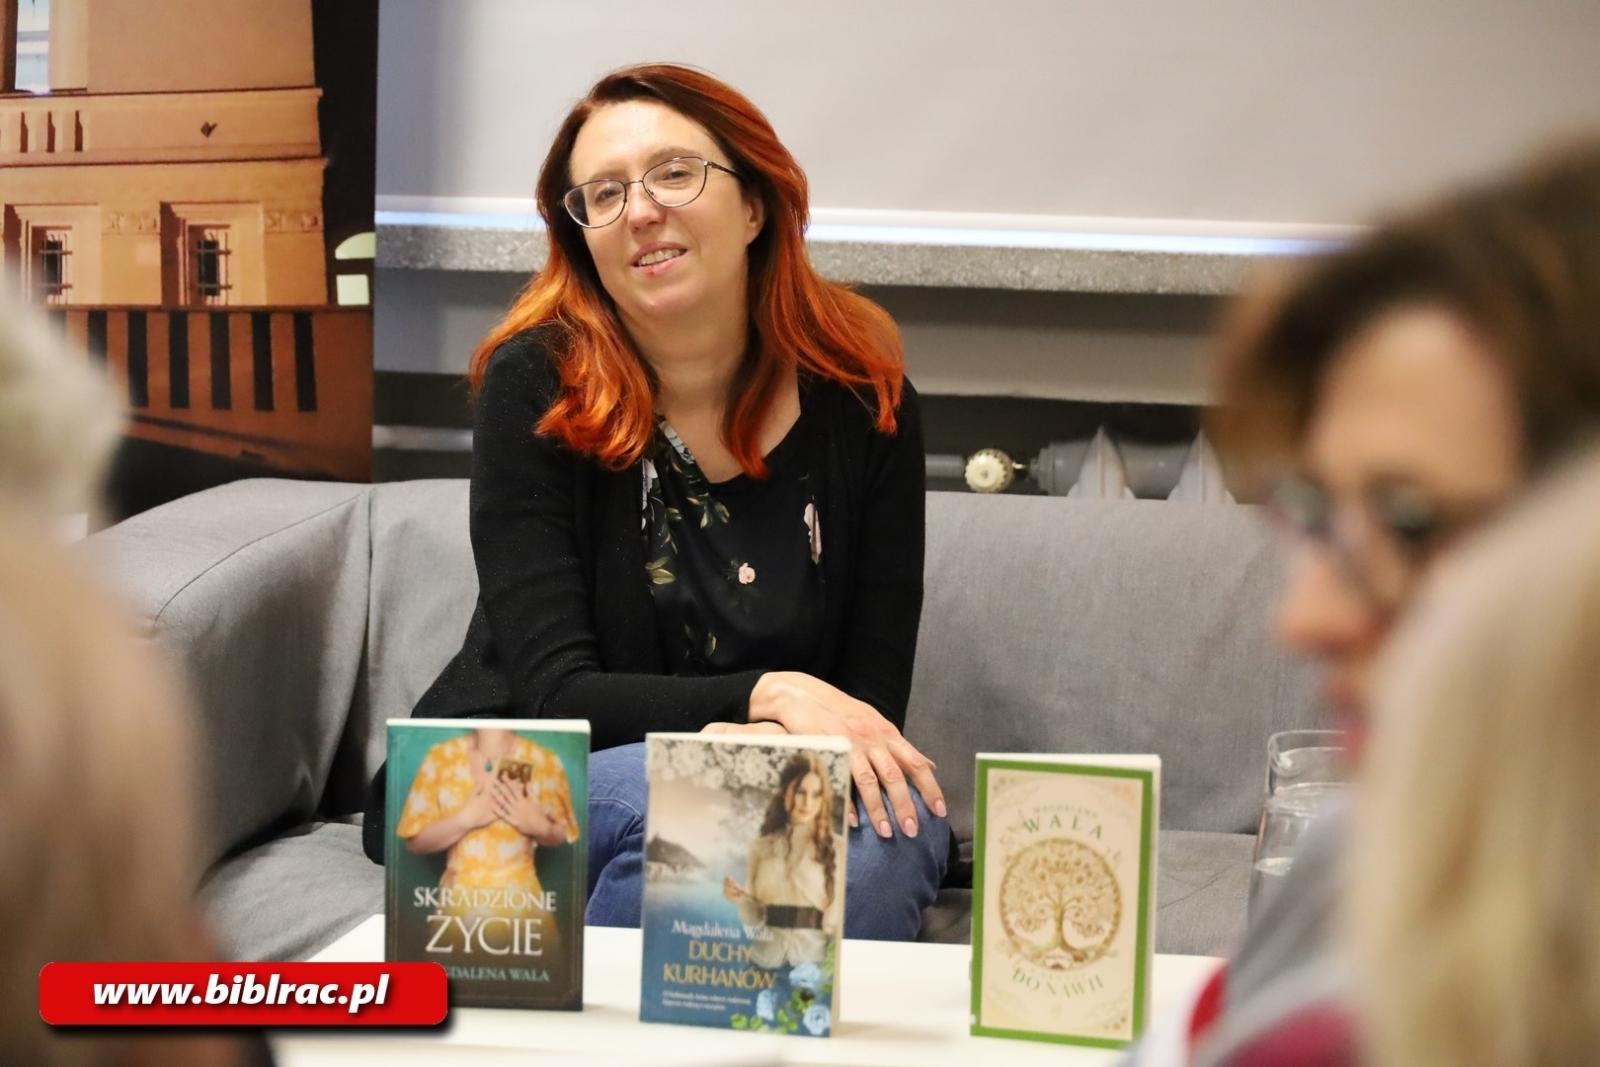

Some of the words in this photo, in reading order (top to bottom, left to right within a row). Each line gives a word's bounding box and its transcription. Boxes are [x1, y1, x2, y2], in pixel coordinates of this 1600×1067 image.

[1024, 814, 1102, 839] WALA
[413, 886, 557, 912] SKRADZIONE
[425, 909, 543, 955] ŻYCIE
[689, 940, 754, 964] DUCHY
[448, 966, 506, 980] DALENA
[509, 968, 549, 982] WALA
[663, 962, 777, 990] KURHANÓW
